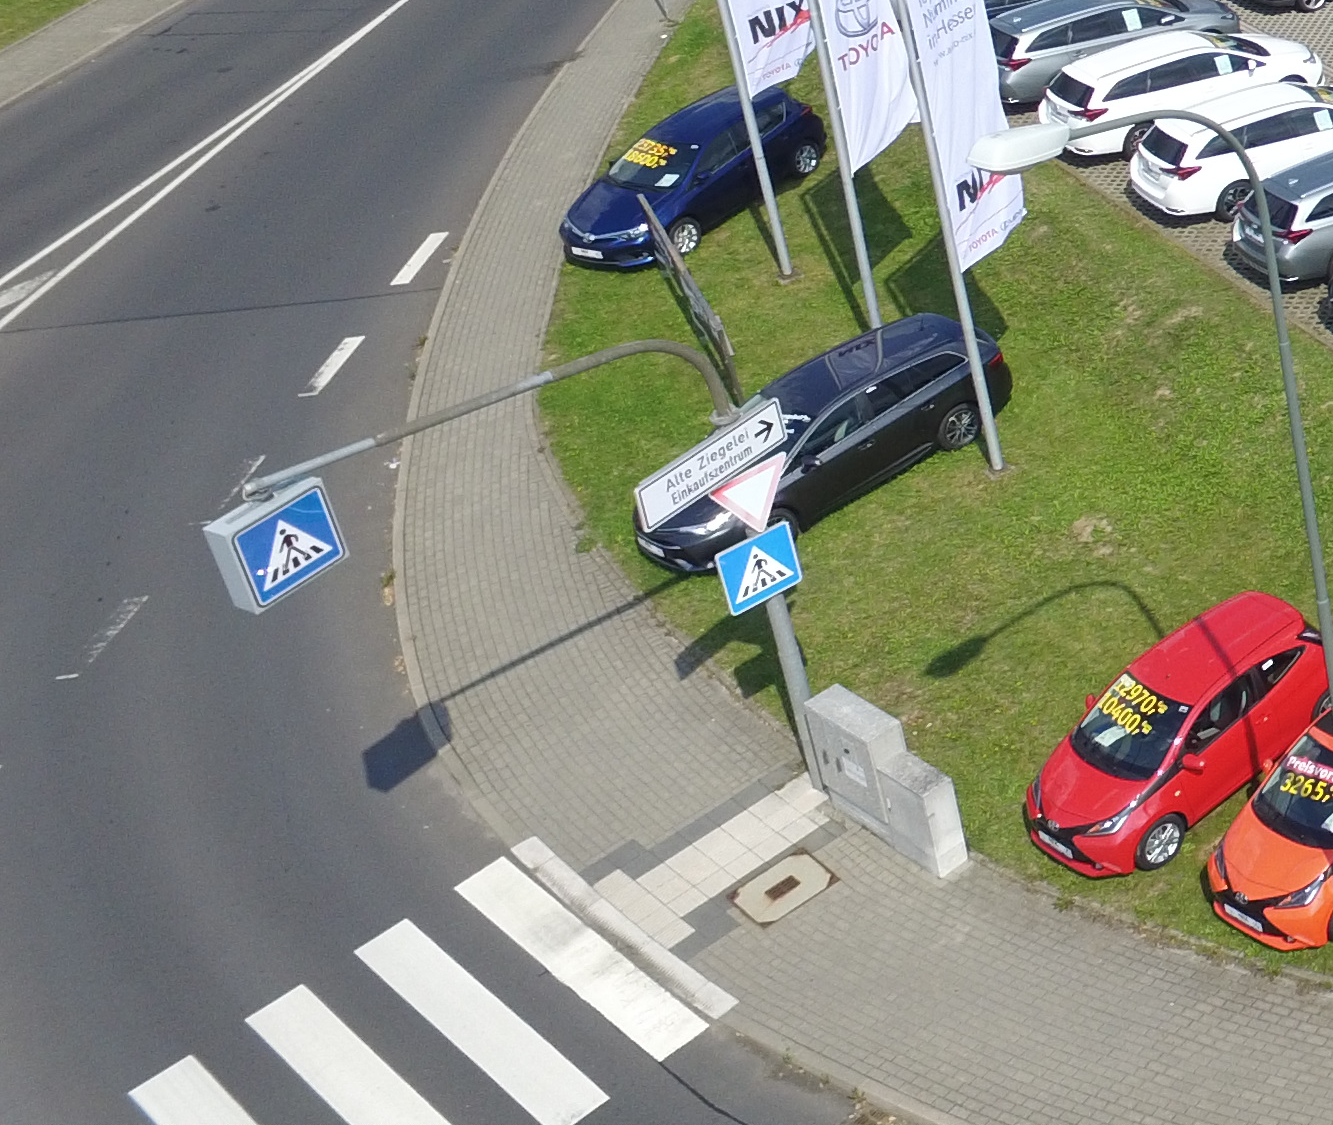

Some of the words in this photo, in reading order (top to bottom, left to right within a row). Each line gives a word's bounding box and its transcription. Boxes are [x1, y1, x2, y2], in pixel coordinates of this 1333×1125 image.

[837, 21, 896, 71] TOYOA
[955, 167, 984, 212] NI
[666, 468, 692, 492] Alte
[697, 427, 750, 471] Ziegelei
[671, 445, 753, 506] Einkaufszentrum
